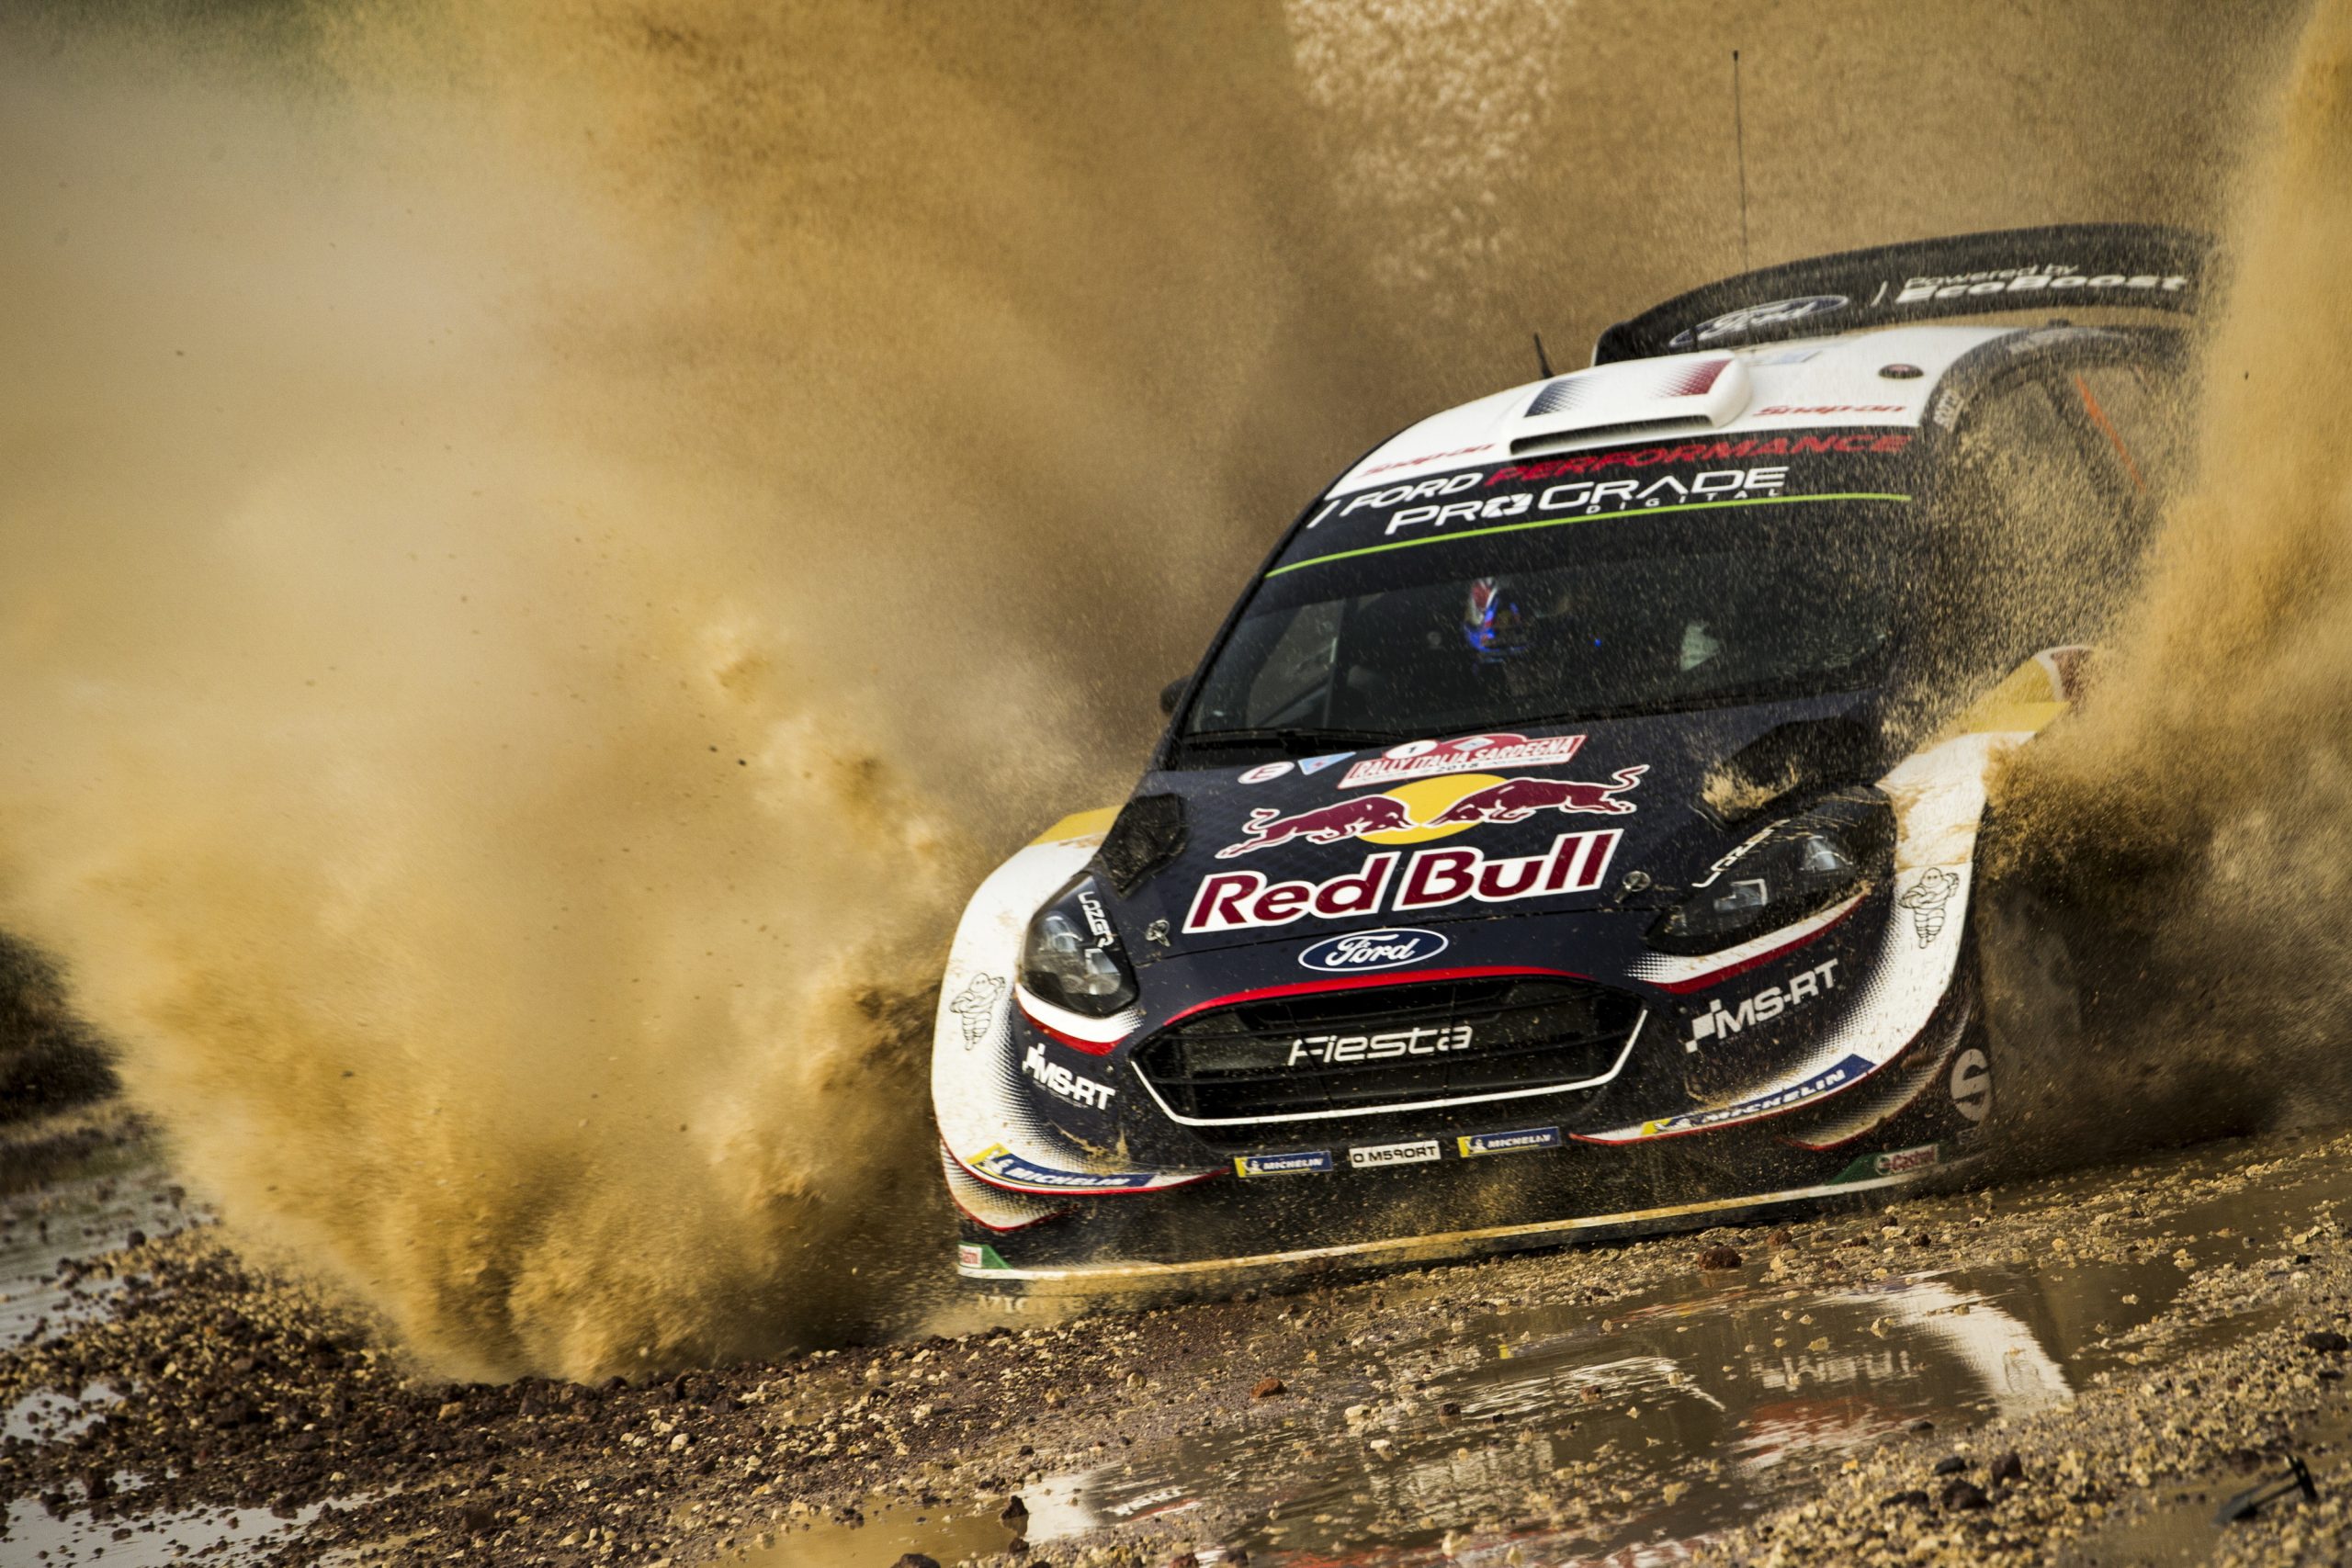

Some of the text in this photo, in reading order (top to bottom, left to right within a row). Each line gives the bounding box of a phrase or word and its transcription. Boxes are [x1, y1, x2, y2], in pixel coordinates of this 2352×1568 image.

[1340, 434, 1912, 517] FORD PERFORMANCE
[1586, 488, 1780, 515] DIGITAL
[1353, 757, 1408, 779] RALLY
[1411, 750, 1471, 771] ITALIA
[1474, 736, 1573, 761] SARDEGNA
[1182, 829, 1624, 933] Red Bull
[1325, 934, 1424, 967] Ford
[1287, 1024, 1474, 1066] Fiesta
[1005, 1167, 1132, 1186] MICHELIN
[1262, 1156, 1324, 1171] MICHELIN
